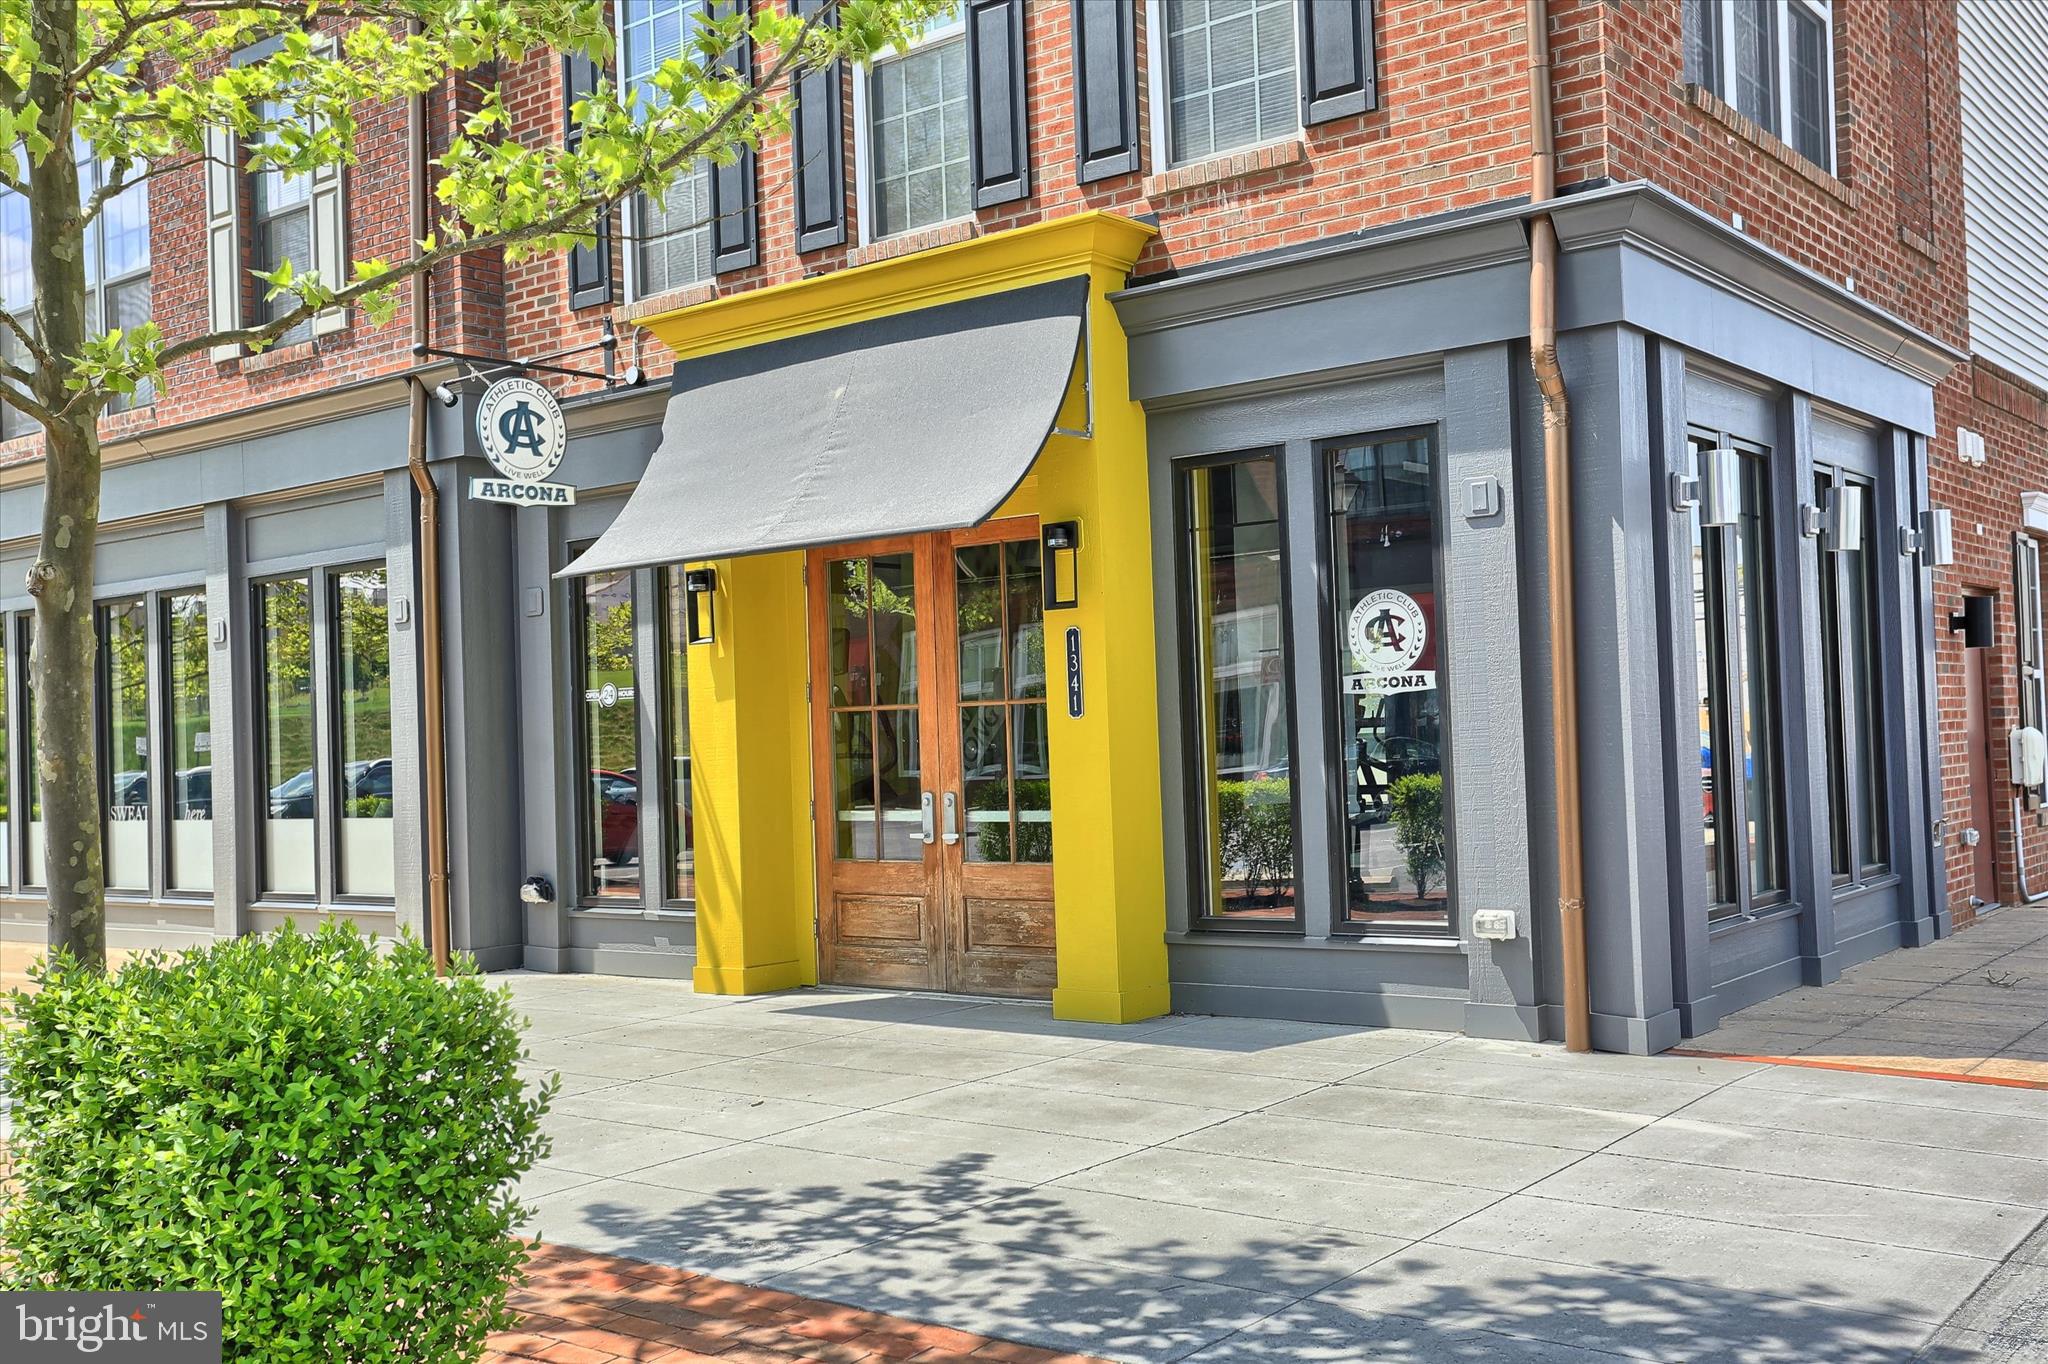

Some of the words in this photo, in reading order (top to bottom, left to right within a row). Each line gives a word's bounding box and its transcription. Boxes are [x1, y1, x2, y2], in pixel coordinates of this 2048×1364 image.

[486, 380, 533, 412] ATHLETIC
[536, 387, 560, 419] CLUB
[503, 465, 522, 479] LIVE
[523, 469, 546, 479] WELL
[480, 482, 568, 502] ARCONA
[1353, 592, 1394, 623] ATHLETIC
[1396, 595, 1419, 618] CLUB
[1070, 634, 1079, 711] 1341
[1387, 661, 1407, 672] WELL
[1351, 675, 1427, 691] ARCONA
[110, 805, 148, 821] SWEAT
[184, 803, 206, 821] here
